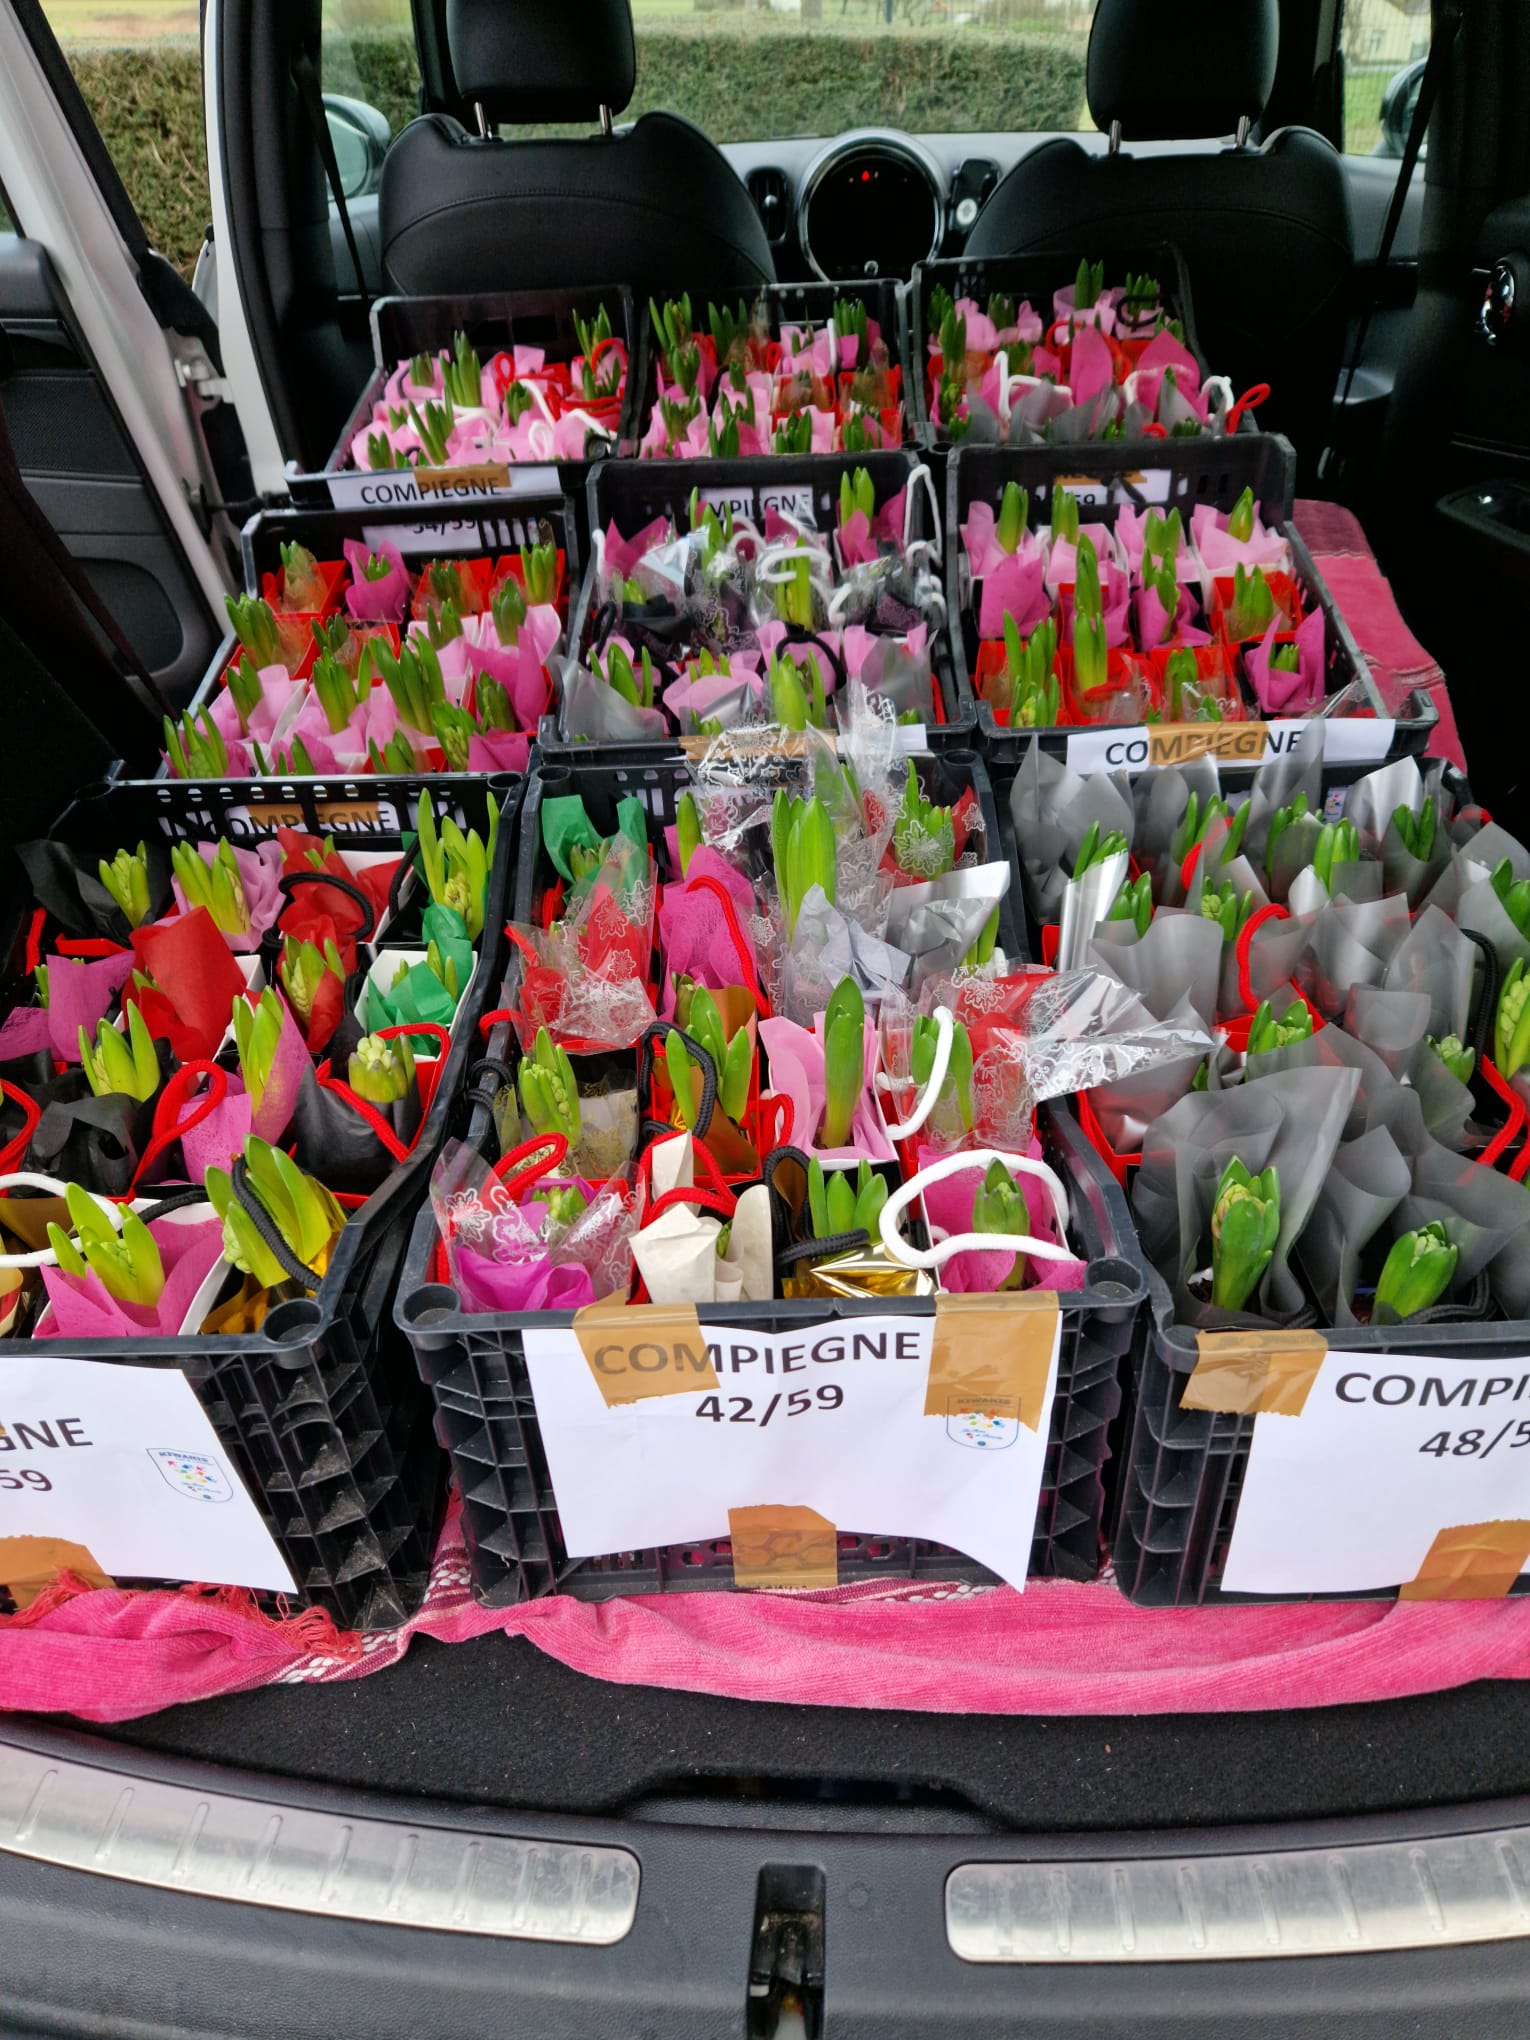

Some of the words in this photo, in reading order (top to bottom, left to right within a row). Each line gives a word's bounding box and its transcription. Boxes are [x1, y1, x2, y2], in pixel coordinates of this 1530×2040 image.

[360, 475, 503, 505] COMPIEGNE
[594, 1332, 921, 1375] COMPIEGNE
[695, 1384, 845, 1427] 42/59
[1335, 1372, 1530, 1406] COMPI
